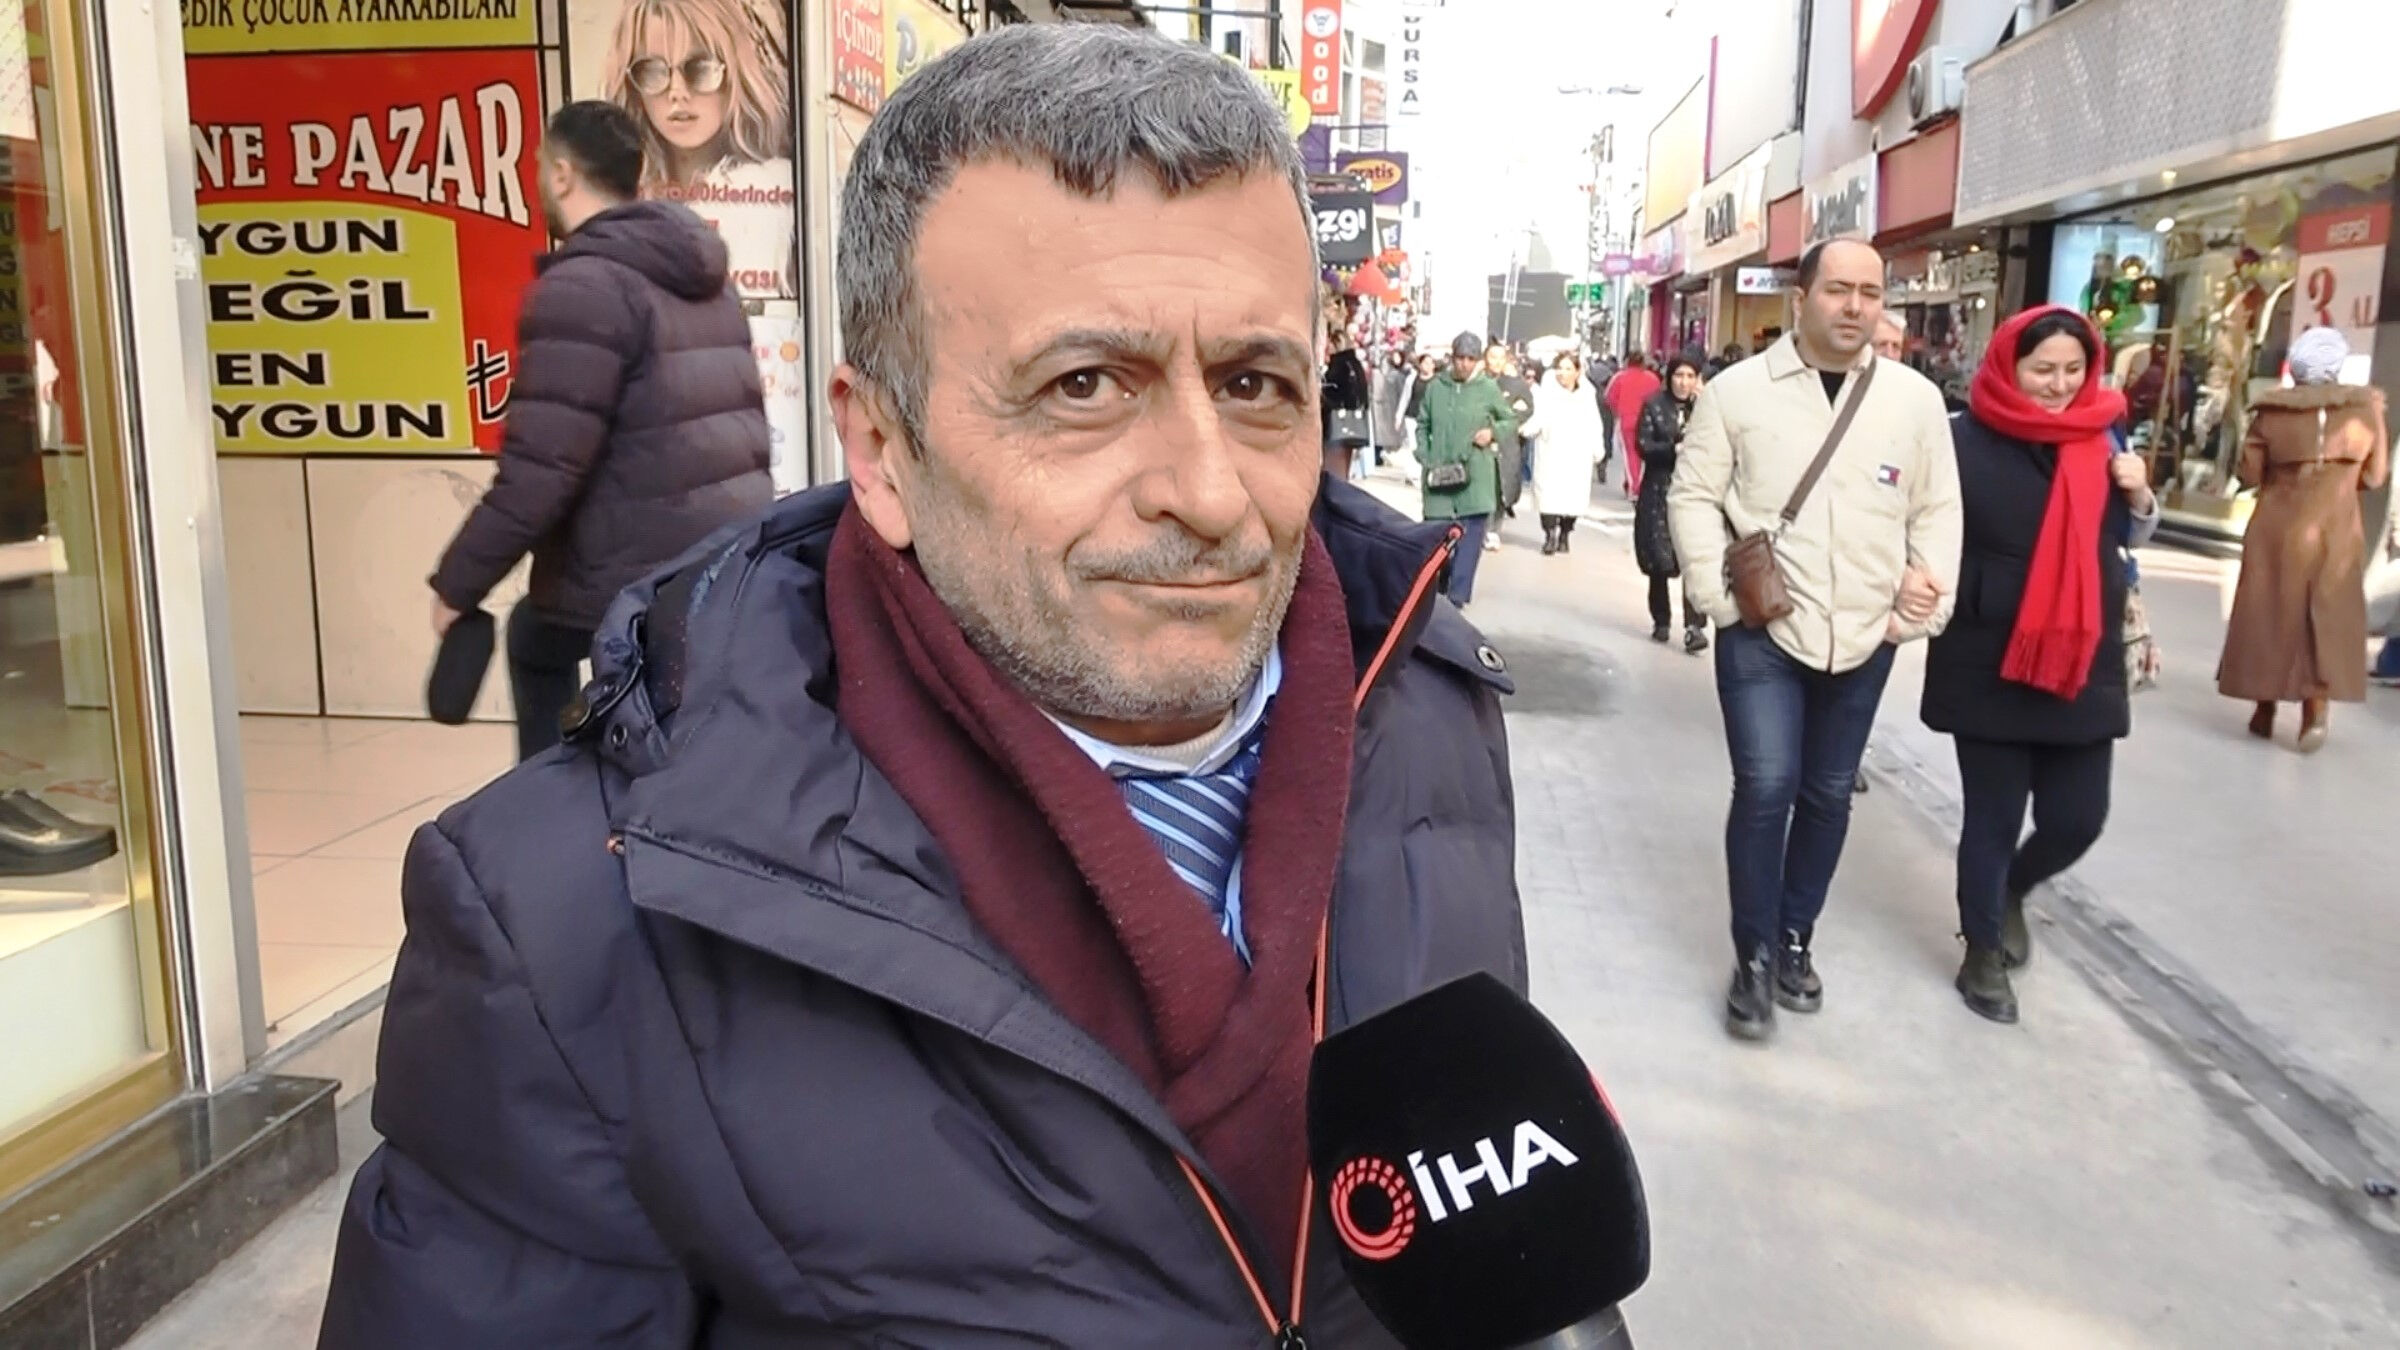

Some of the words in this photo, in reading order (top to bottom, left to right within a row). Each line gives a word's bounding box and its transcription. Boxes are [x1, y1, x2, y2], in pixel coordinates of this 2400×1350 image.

[243, 0, 328, 33] ÇOCUK
[290, 81, 530, 228] PAZAR
[216, 352, 326, 386] EN
[212, 403, 445, 439] YGUN
[1406, 1118, 1580, 1223] İHA
